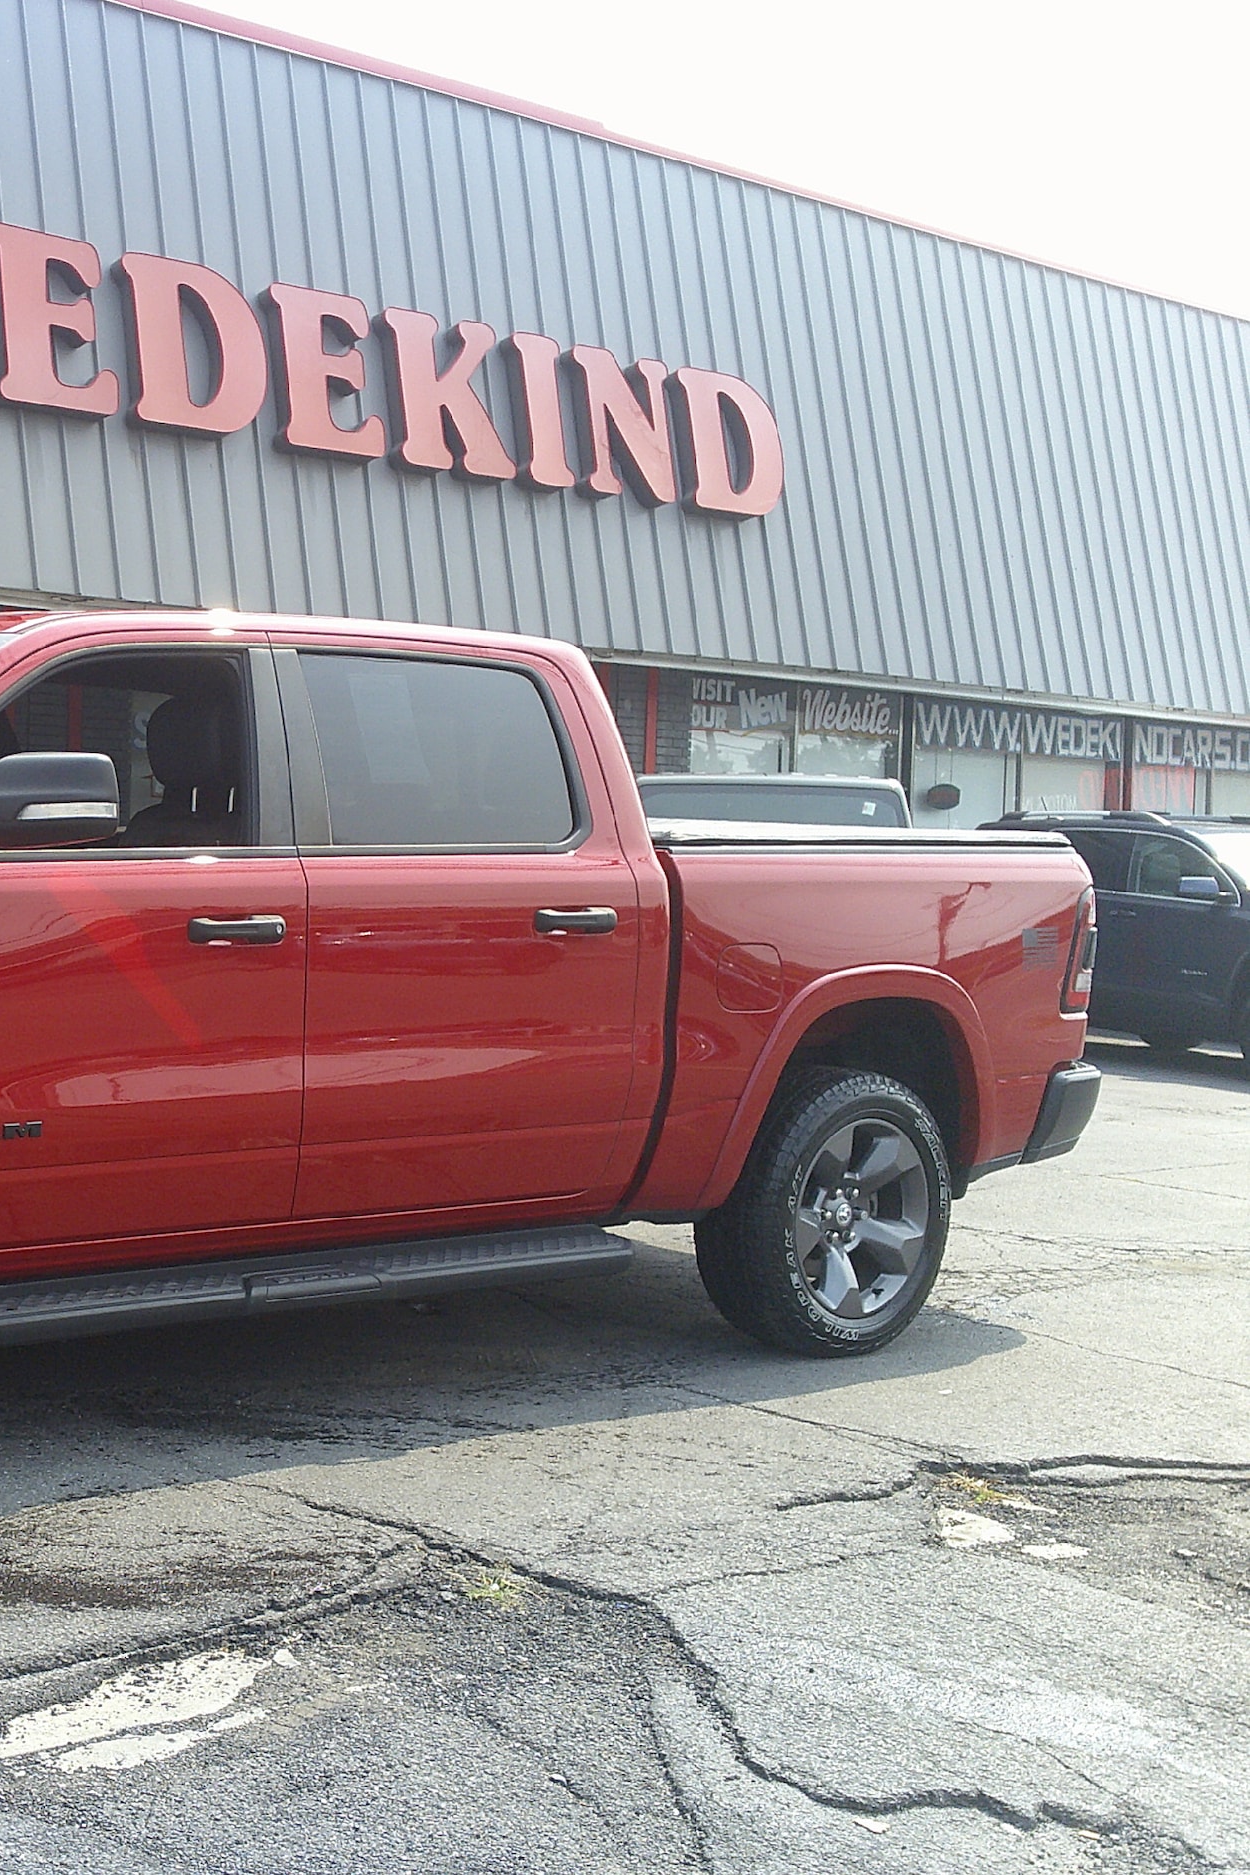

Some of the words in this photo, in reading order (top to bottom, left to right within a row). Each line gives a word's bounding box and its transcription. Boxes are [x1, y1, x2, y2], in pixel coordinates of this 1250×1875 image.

[691, 677, 736, 703] VISIT
[691, 704, 728, 730] OUR
[738, 688, 788, 730] New
